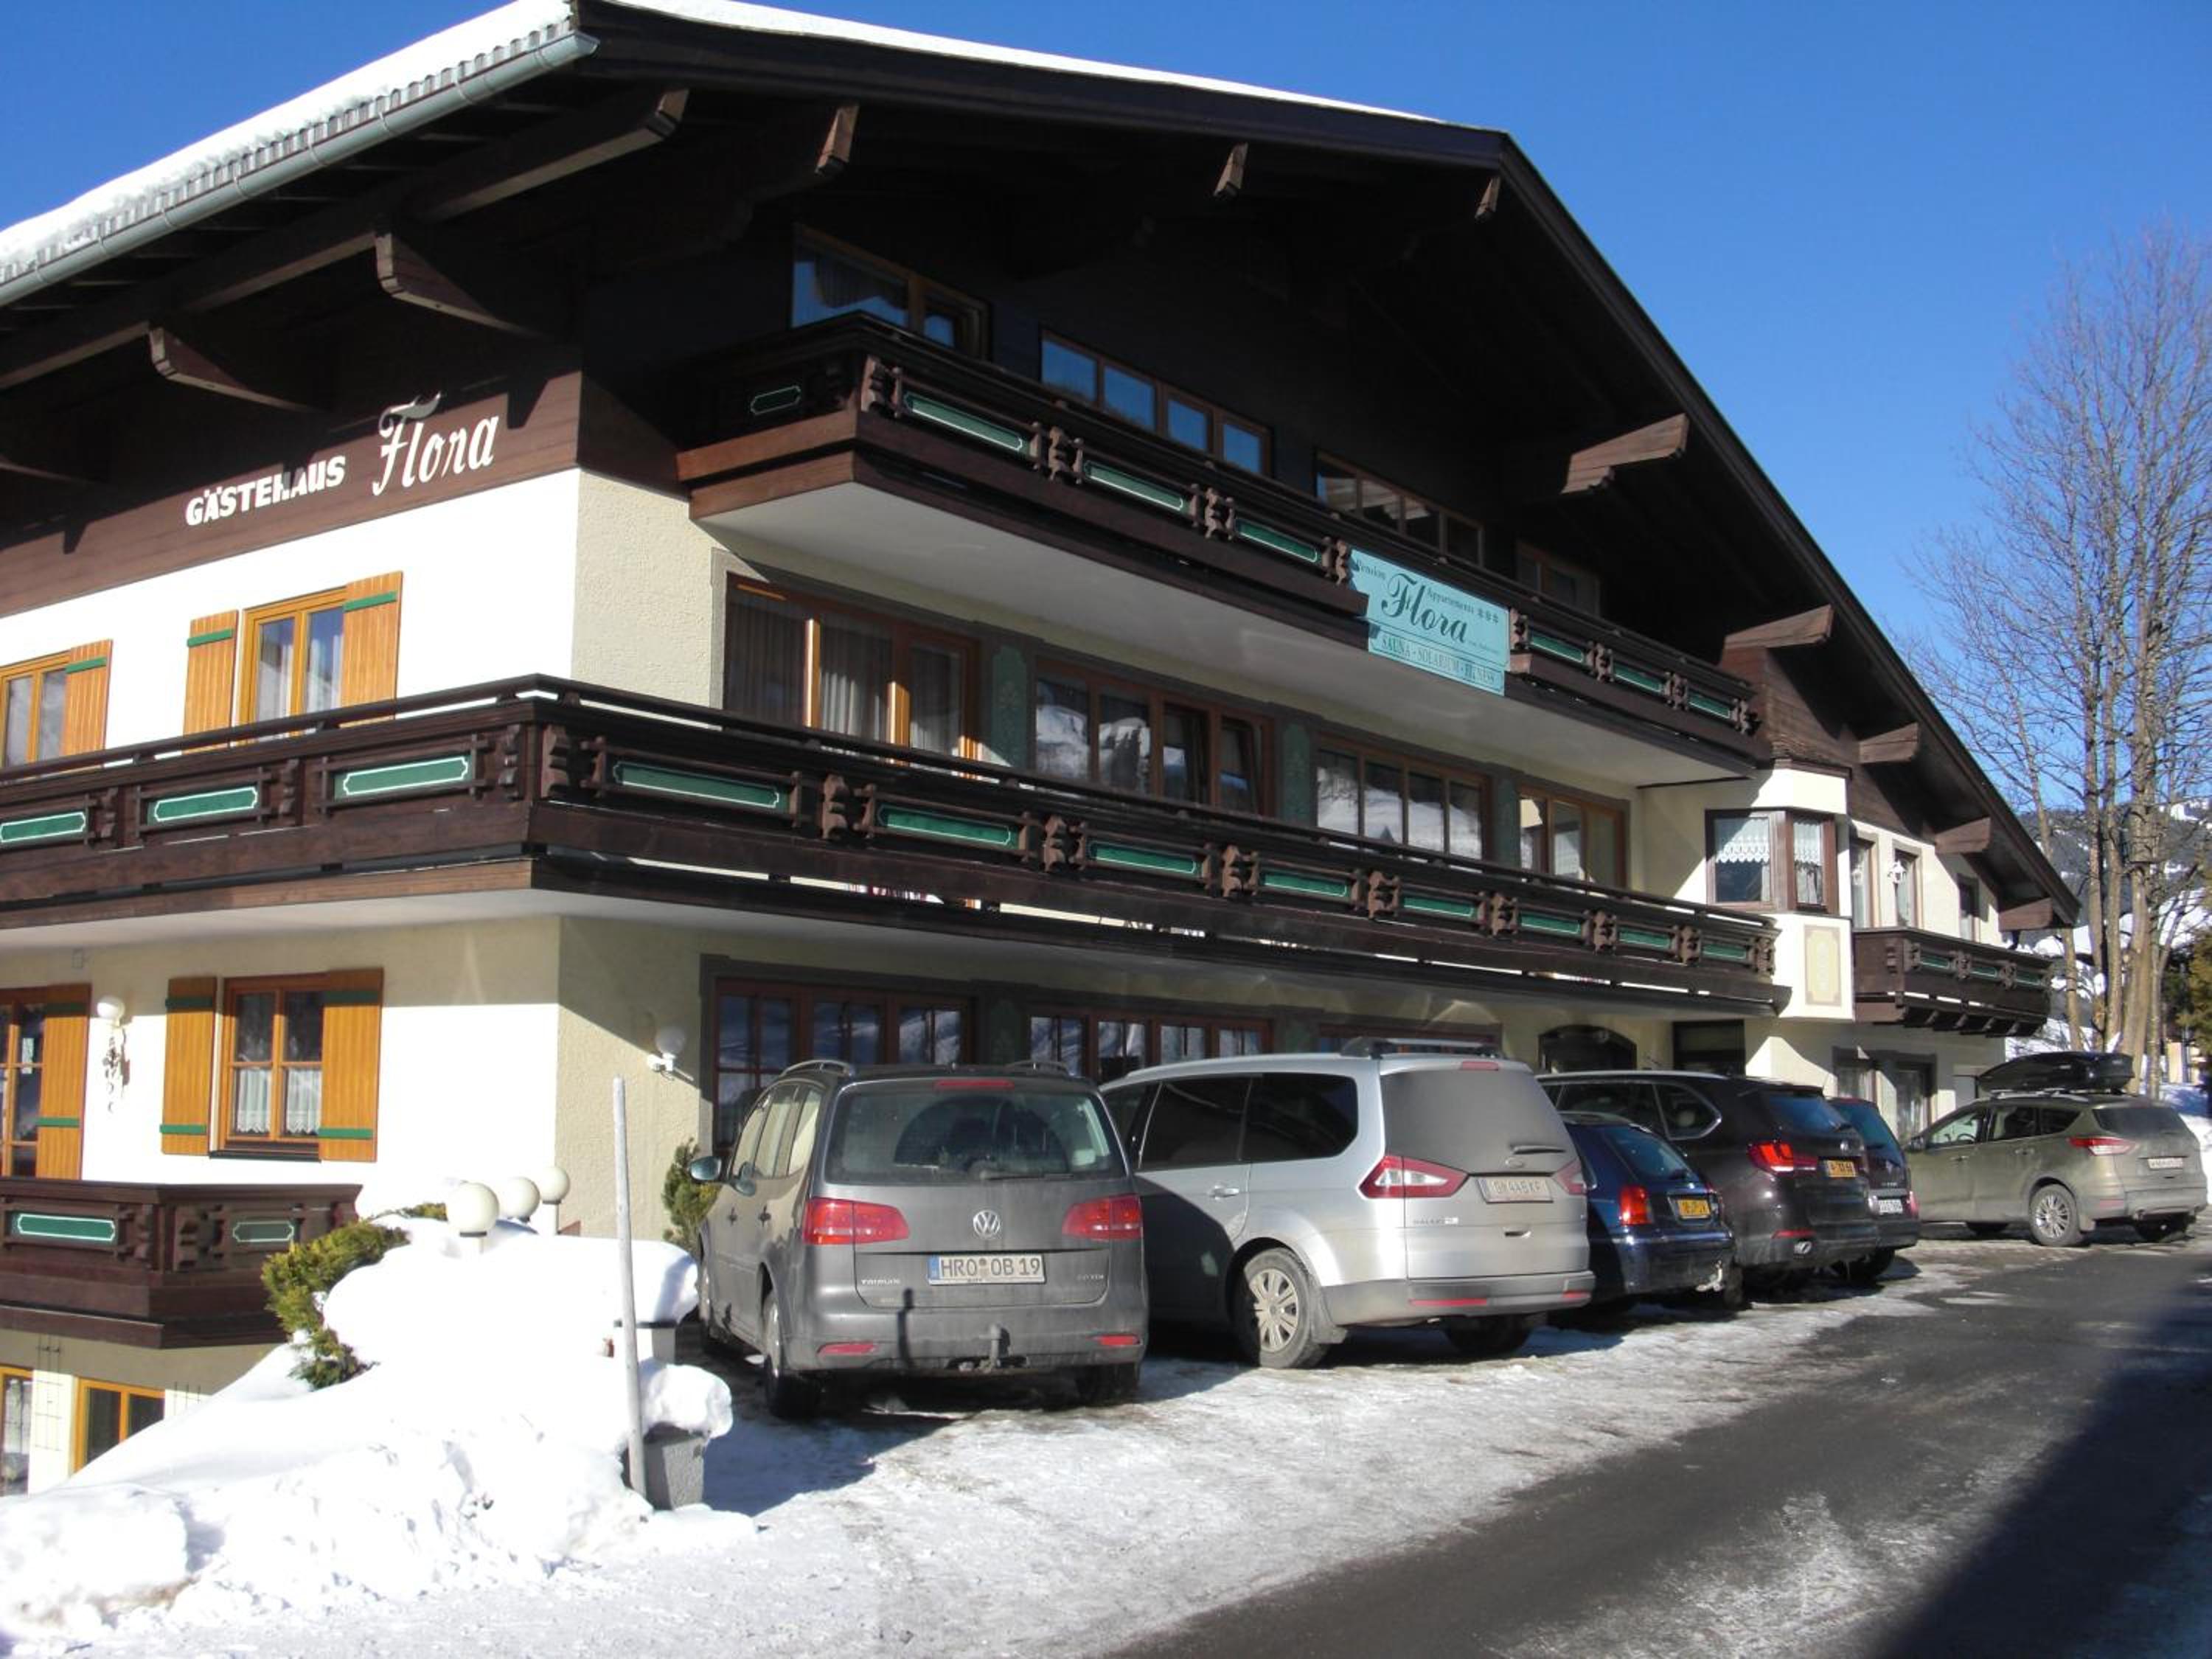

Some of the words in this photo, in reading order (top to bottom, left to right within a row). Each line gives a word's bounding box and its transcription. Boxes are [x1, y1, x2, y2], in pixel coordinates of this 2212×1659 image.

[185, 456, 346, 526] GÄSTEHAUS
[372, 391, 499, 496] Flora
[1381, 572, 1468, 643] Flora
[941, 1258, 978, 1277] HRO
[991, 1258, 1014, 1276] OB
[1020, 1257, 1040, 1276] 19
